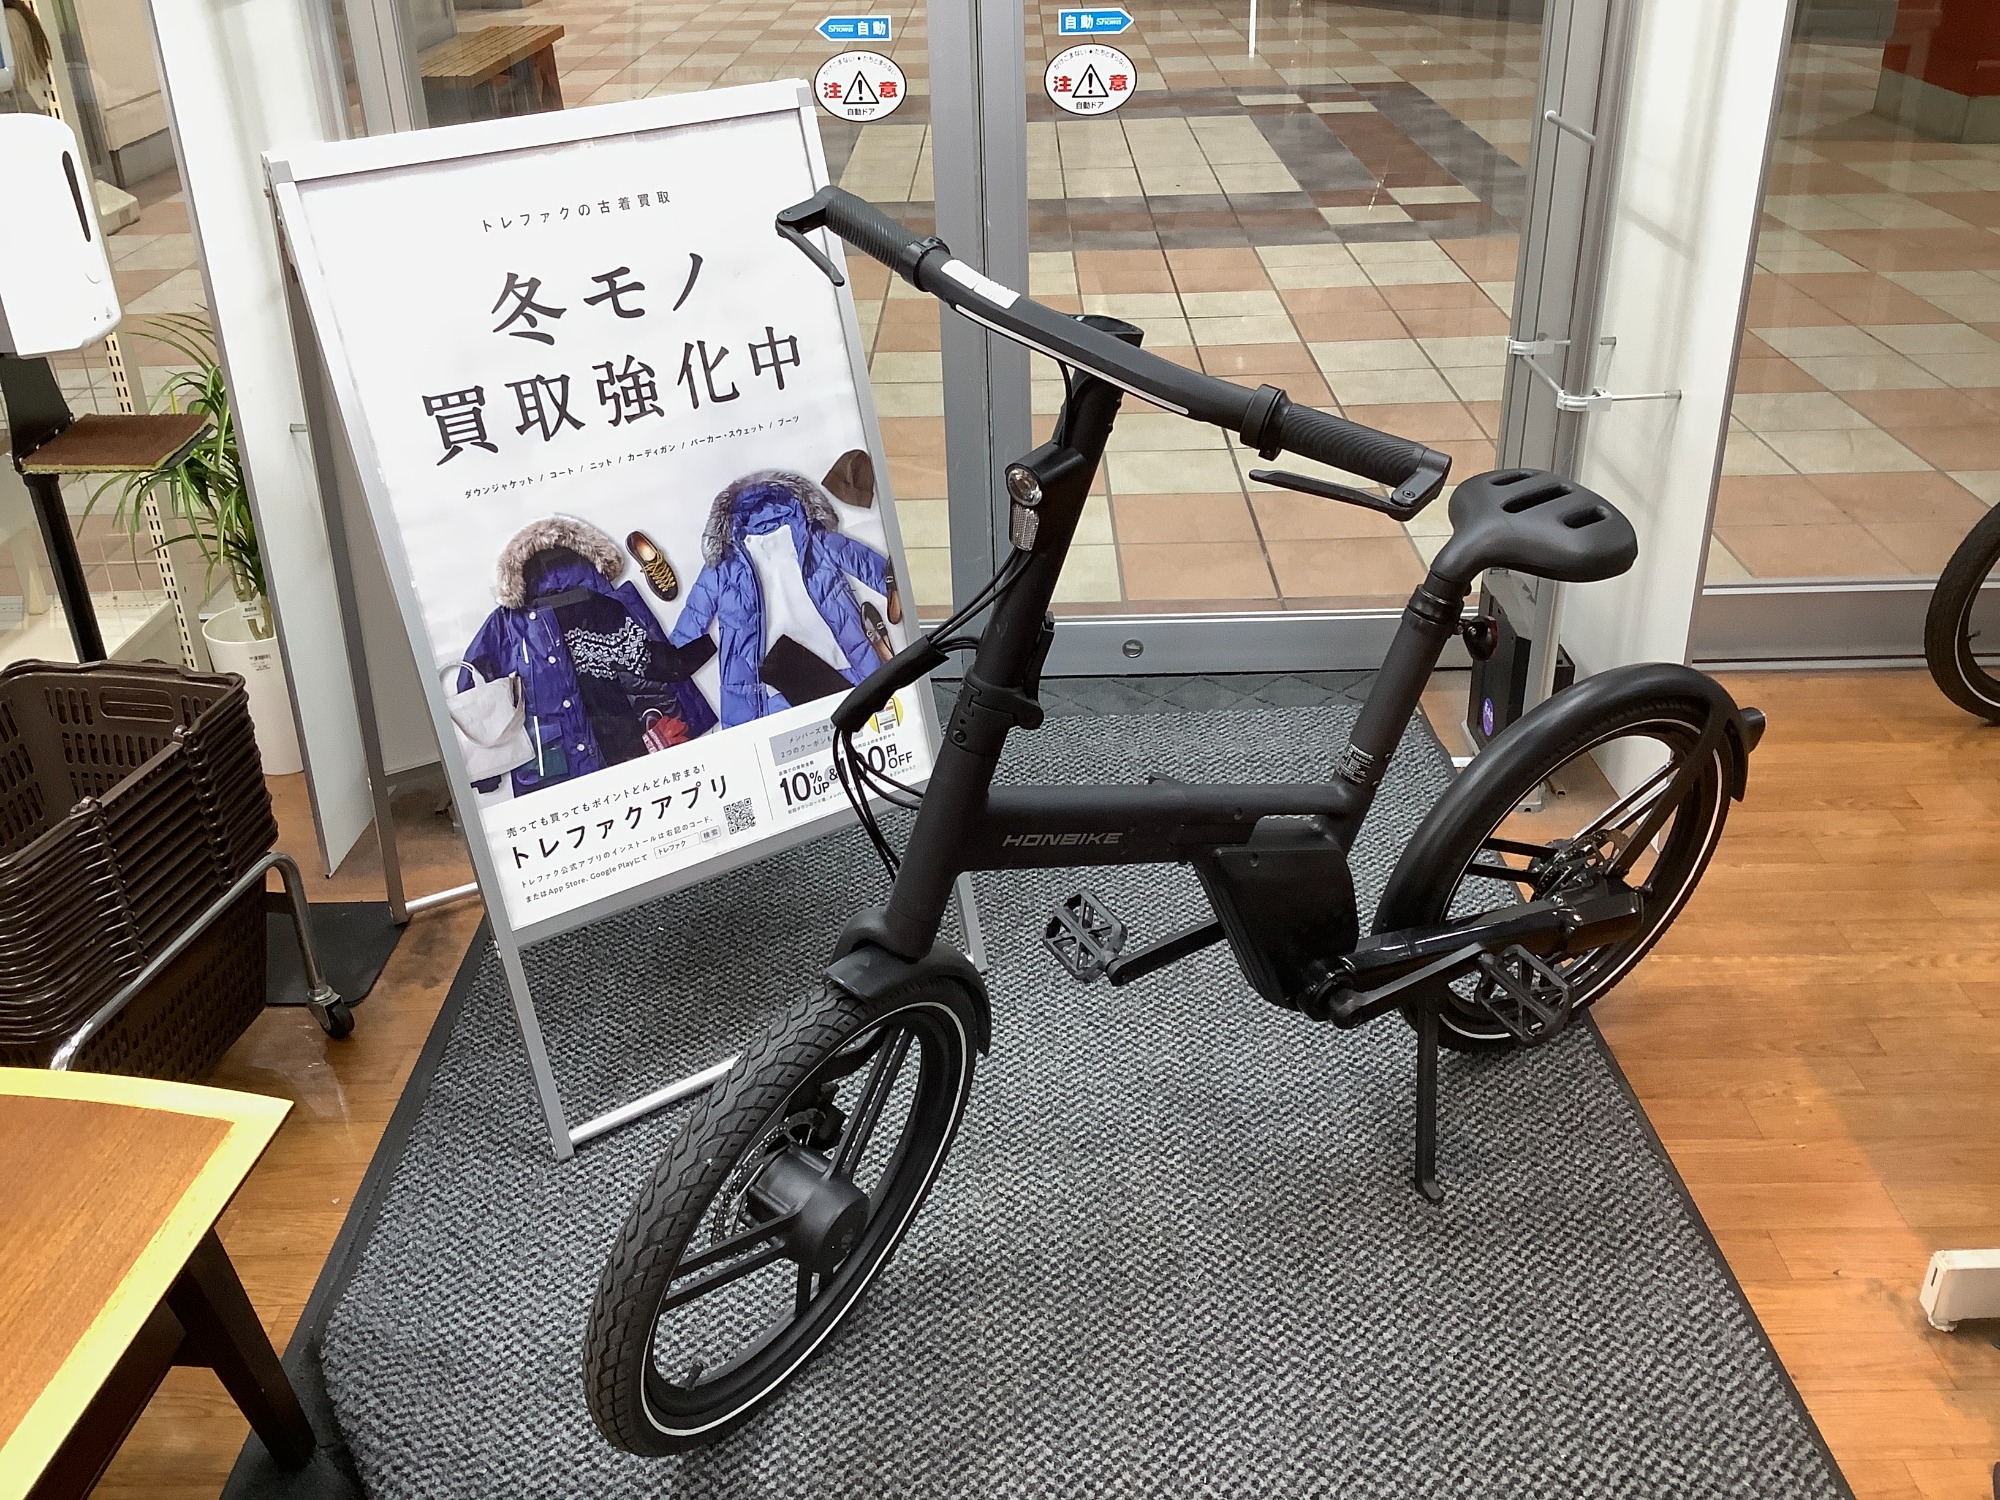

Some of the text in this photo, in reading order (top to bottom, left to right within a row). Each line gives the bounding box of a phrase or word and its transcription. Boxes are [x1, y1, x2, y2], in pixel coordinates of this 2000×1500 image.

[857, 20, 886, 36] 自動
[1065, 14, 1093, 30] 自動
[847, 107, 875, 116] 自動ドア
[1076, 101, 1104, 110] 自動ドア
[482, 190, 671, 233] トレファクの古着買取
[491, 252, 704, 346] 冬モノ
[421, 326, 801, 466] 買取強化中
[888, 751, 913, 769] OFF
[511, 775, 727, 869] トレファクアプリ
[1002, 832, 1124, 847] HONBIKE
[658, 840, 686, 856] トレファク
